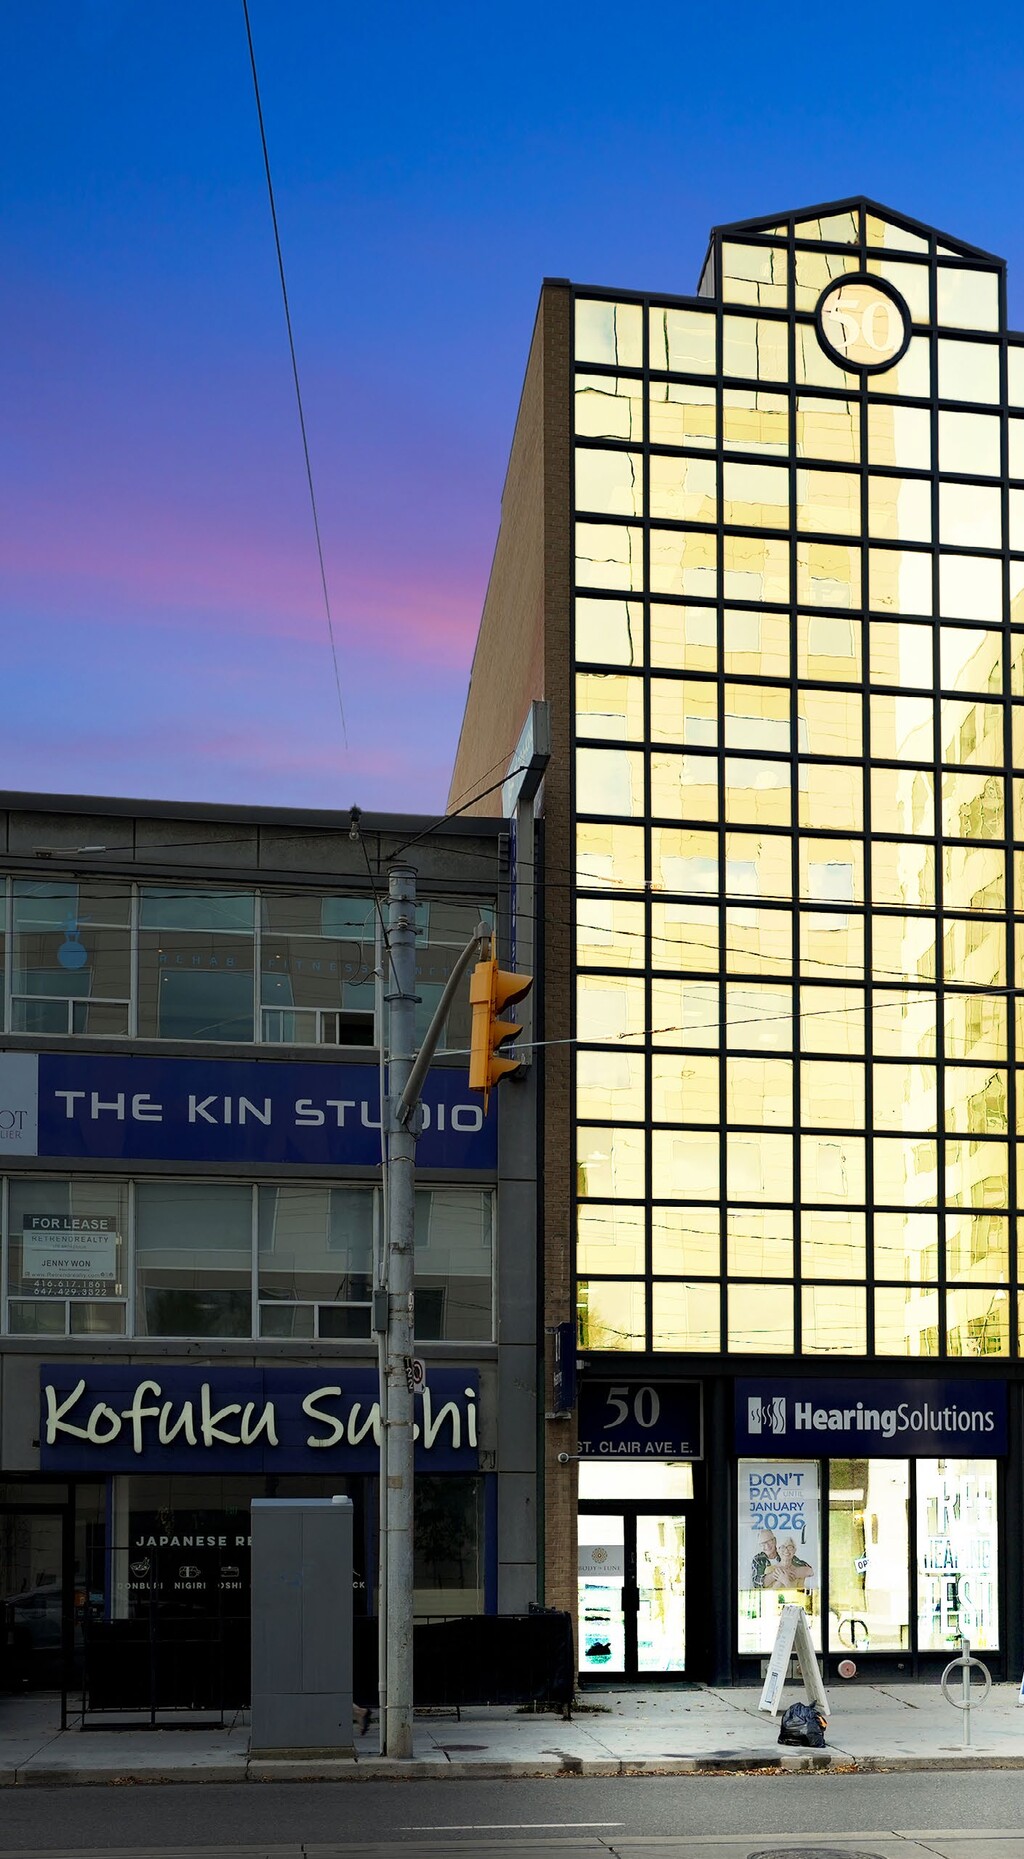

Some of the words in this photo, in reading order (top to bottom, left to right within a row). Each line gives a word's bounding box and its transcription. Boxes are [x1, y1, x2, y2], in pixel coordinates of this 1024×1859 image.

[829, 299, 899, 352] 50
[54, 1090, 163, 1122] THE
[188, 1094, 272, 1126] KIN
[294, 1098, 484, 1132] STUIO
[32, 1217, 60, 1229] FOR
[63, 1218, 108, 1230] LEASE
[41, 1259, 69, 1267] JENNY
[603, 1386, 661, 1429] 50
[45, 1379, 279, 1453] Kofuku
[302, 1386, 478, 1449] Suhi
[795, 1402, 995, 1438] HearingSolutions
[576, 1441, 595, 1453] ST.
[599, 1441, 641, 1453] CLAIR
[644, 1441, 676, 1453] AVE.
[680, 1441, 693, 1453] E.
[749, 1473, 804, 1487] DON'T
[749, 1487, 782, 1501] PAY
[750, 1502, 805, 1512] JANUARY
[751, 1512, 806, 1530] 2026
[135, 1535, 228, 1547] JAPANESE
[174, 1582, 207, 1590] NIGIRI
